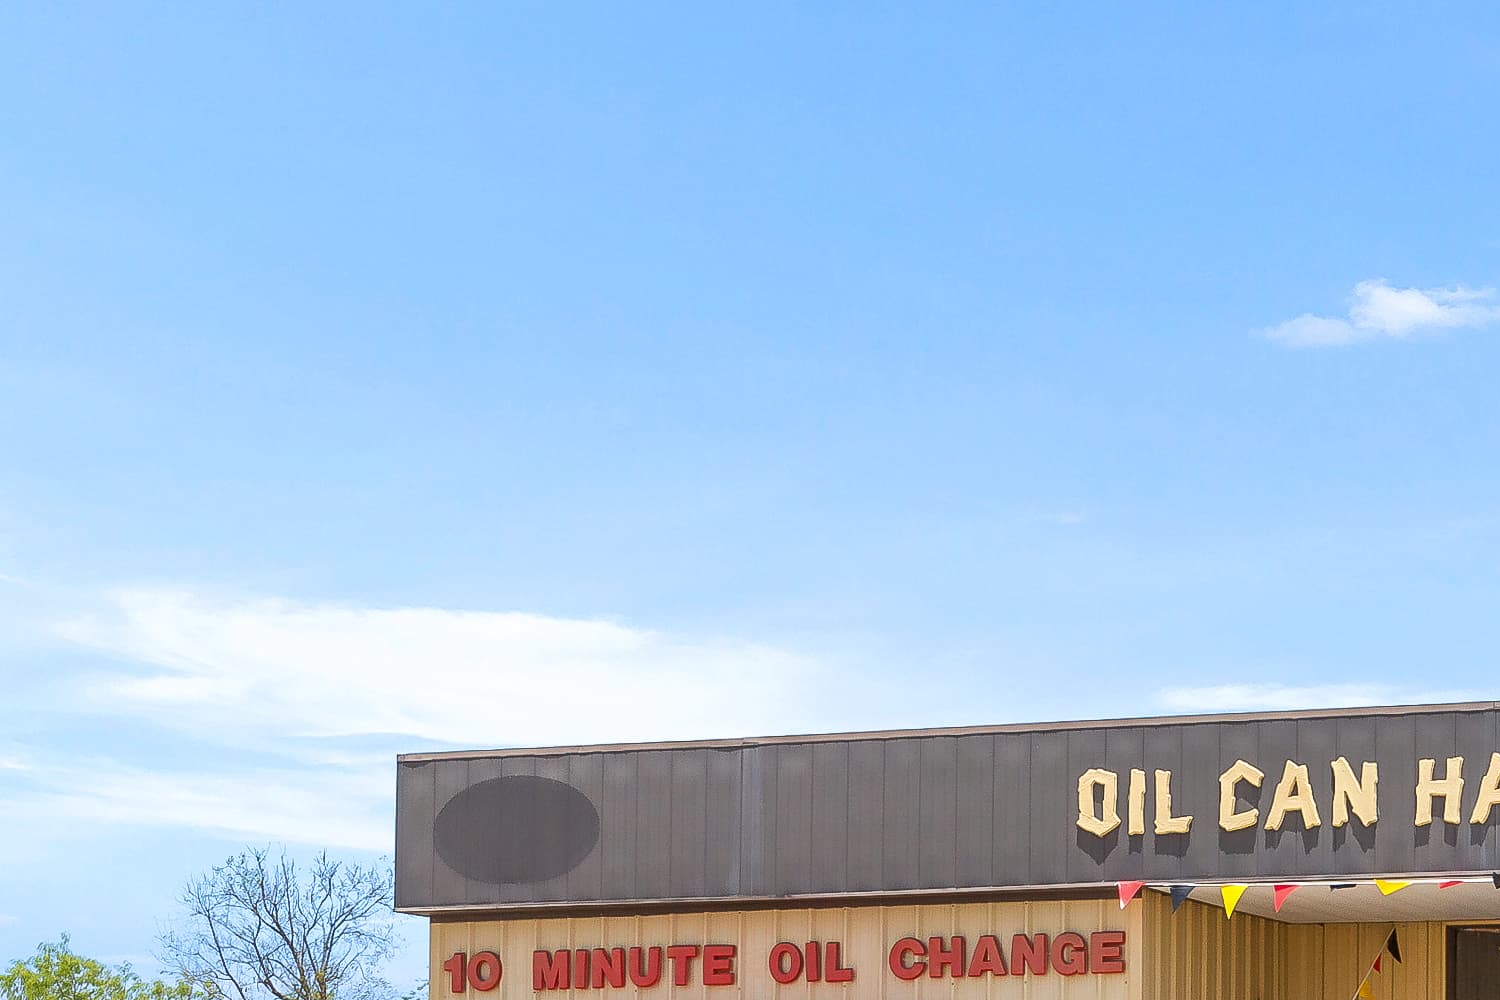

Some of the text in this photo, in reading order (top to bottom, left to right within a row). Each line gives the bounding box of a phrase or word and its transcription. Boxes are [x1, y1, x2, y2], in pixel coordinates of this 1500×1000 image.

[1077, 766, 1193, 837] OIL
[1219, 756, 1379, 832] CAN
[444, 931, 1127, 994] 10 MINUTE OIL CHANGE
